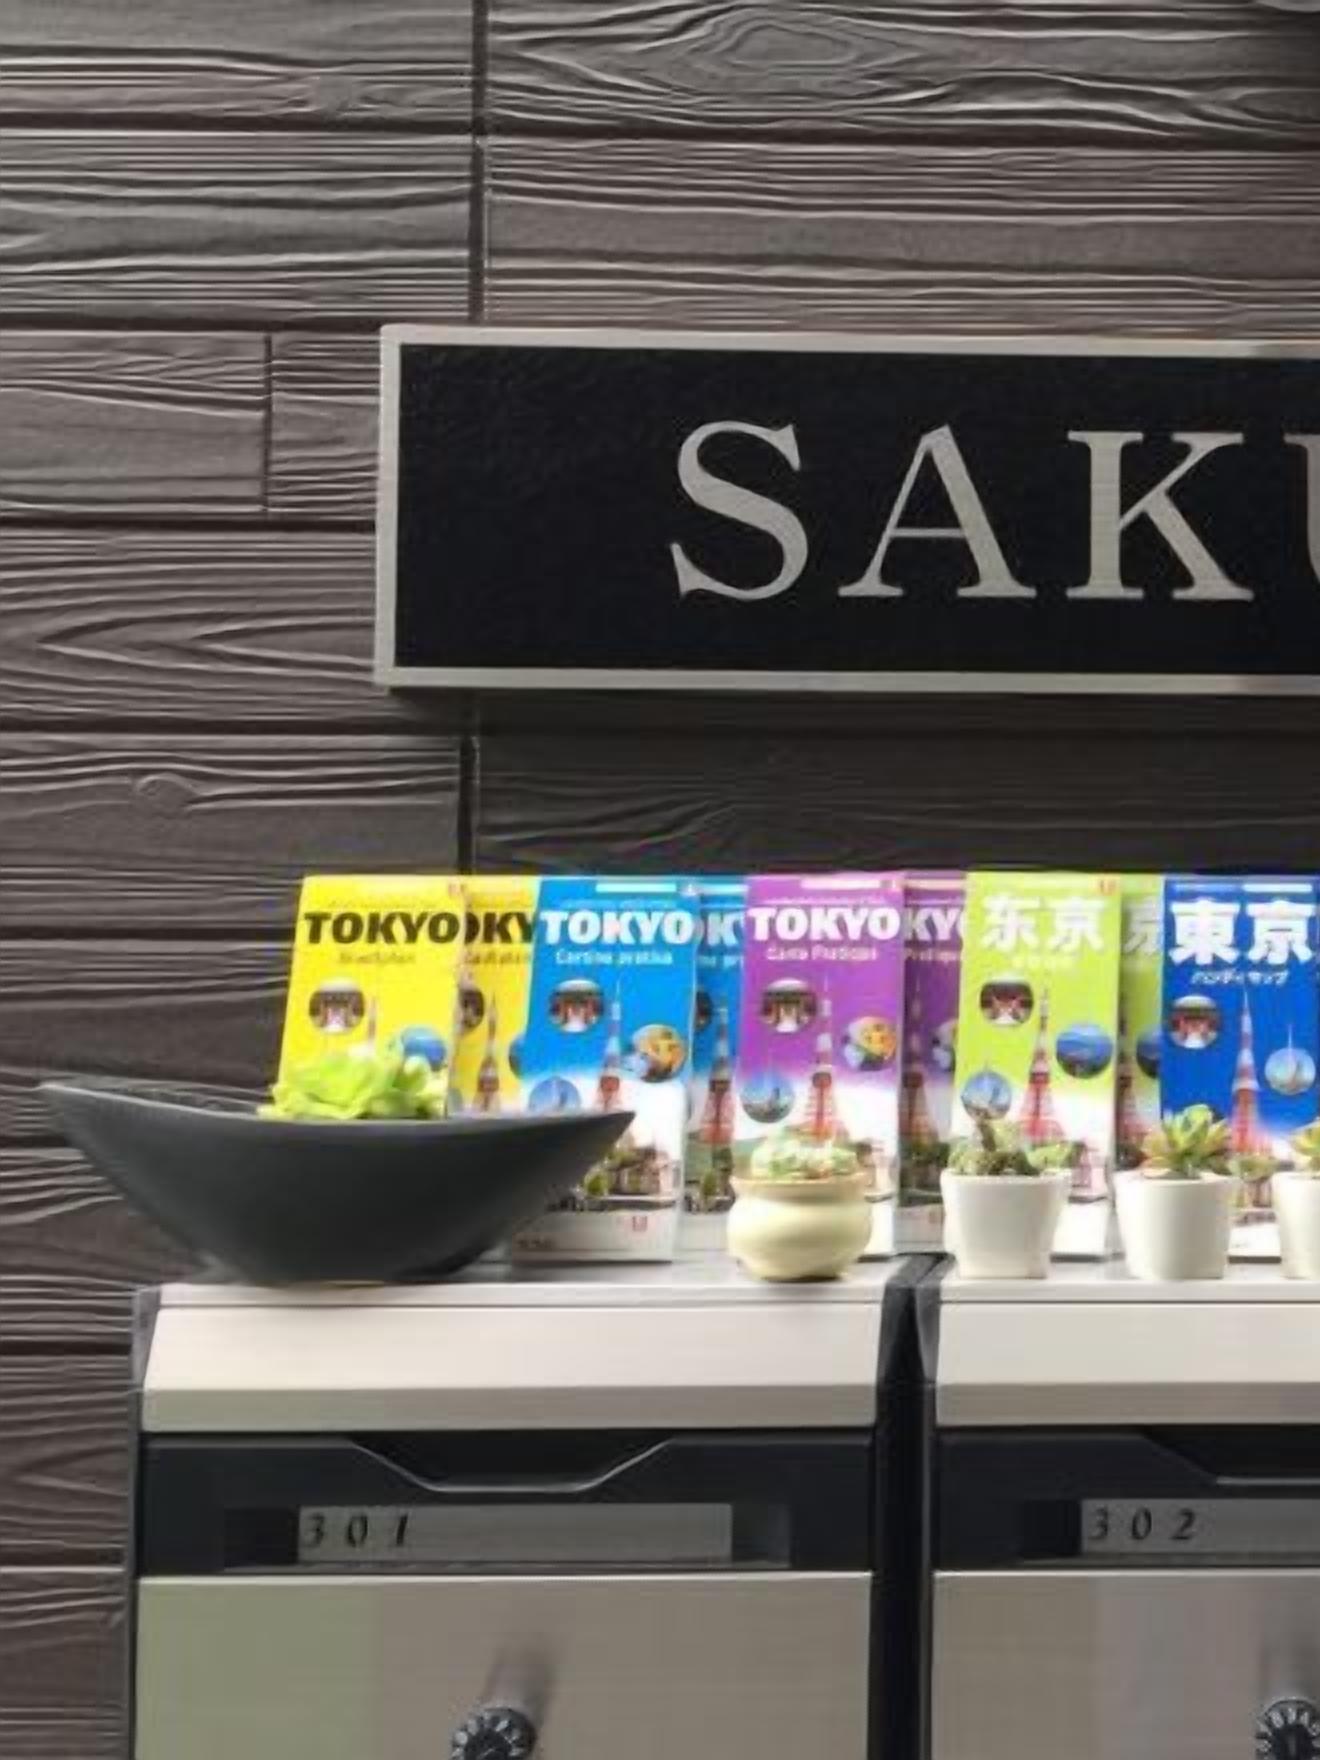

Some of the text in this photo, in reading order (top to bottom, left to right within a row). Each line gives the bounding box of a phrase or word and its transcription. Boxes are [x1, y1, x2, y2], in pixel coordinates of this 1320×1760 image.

[304, 911, 460, 944] TOKYO
[540, 909, 695, 945] TOKYO
[747, 906, 901, 941] TOKYO
[980, 895, 1106, 951] 东京
[1169, 896, 1316, 966] 東京
[302, 1512, 410, 1549] 301
[1088, 1507, 1197, 1542] 302
